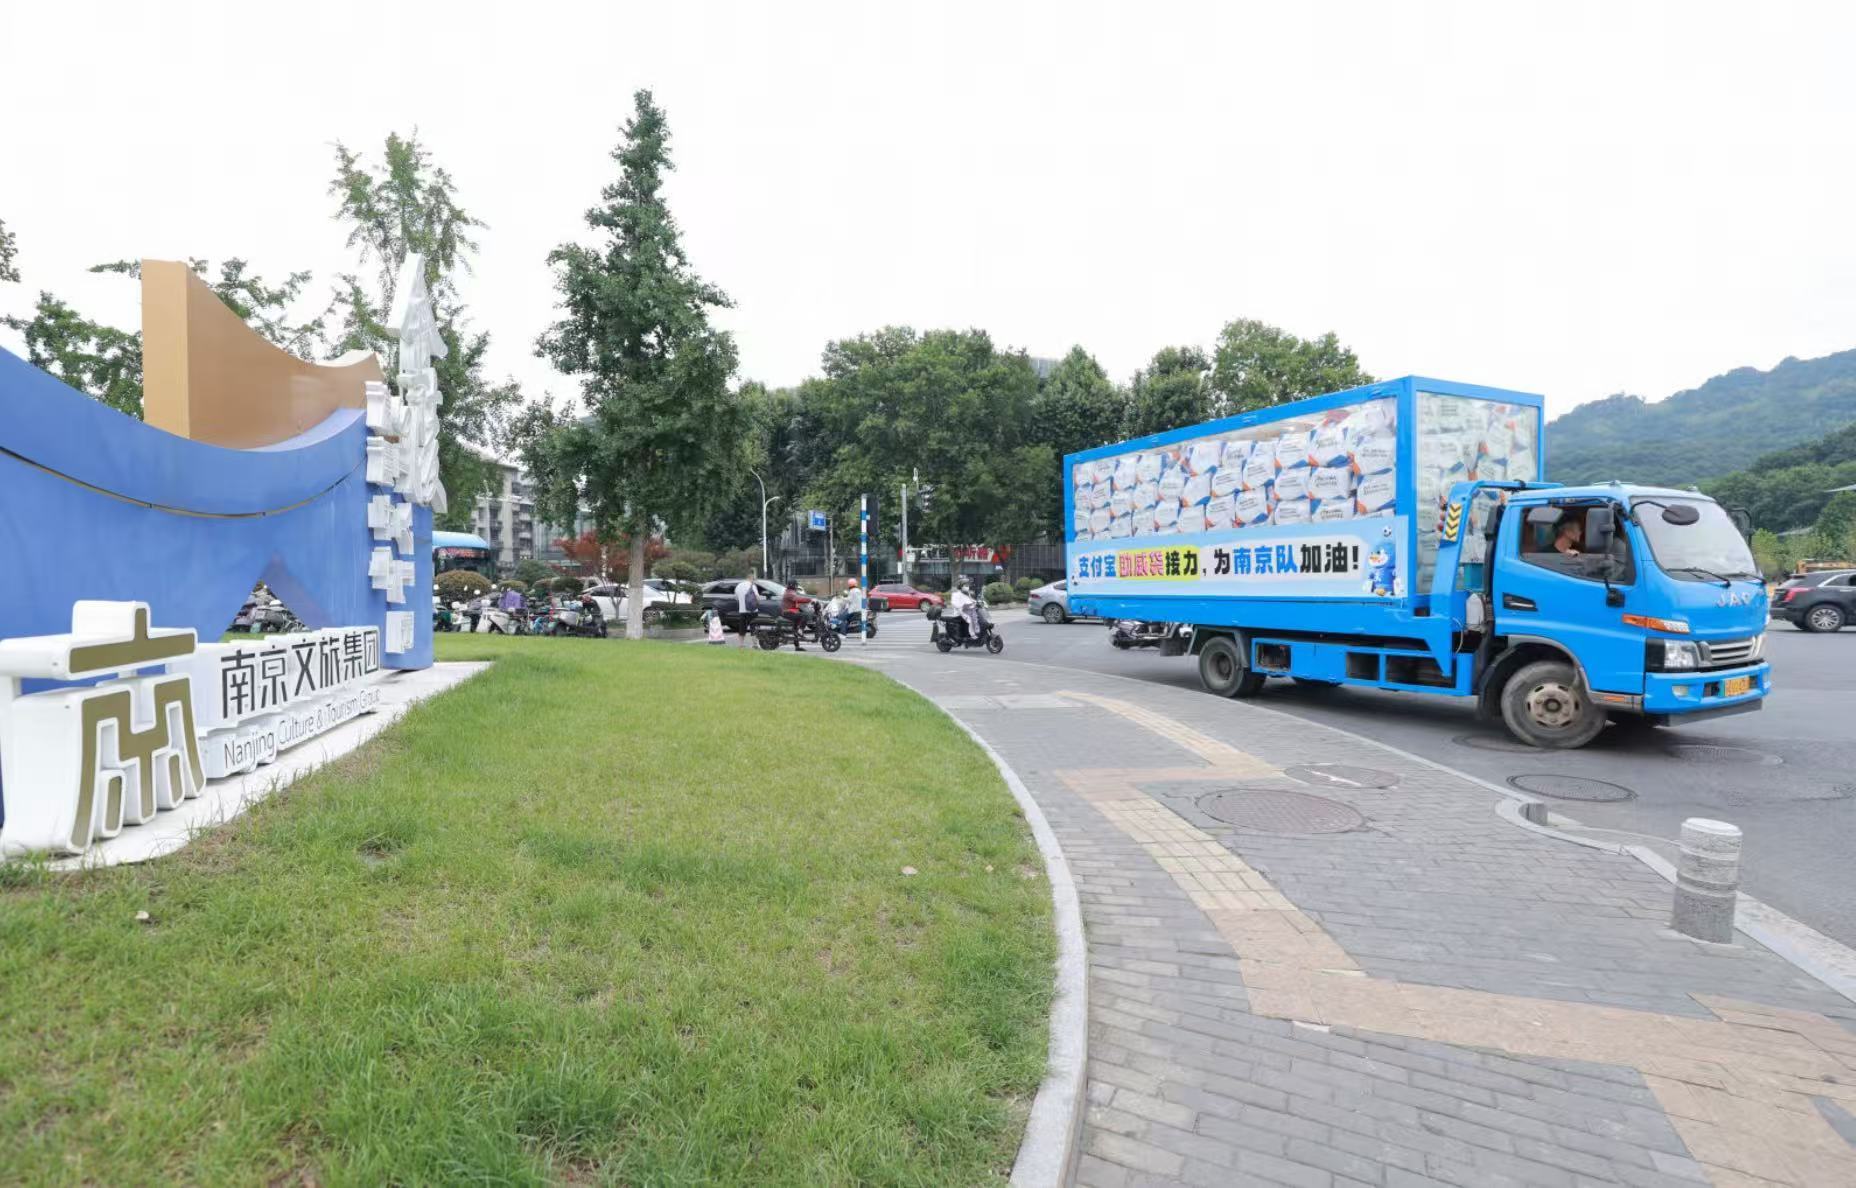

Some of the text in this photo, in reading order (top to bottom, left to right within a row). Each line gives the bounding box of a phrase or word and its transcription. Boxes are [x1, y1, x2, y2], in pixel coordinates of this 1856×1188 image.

[220, 630, 379, 719] 南京文旅集团
[224, 731, 275, 769] Nanjing
[279, 715, 314, 745] Culture
[316, 709, 323, 728] &
[326, 697, 359, 723] Tourism
